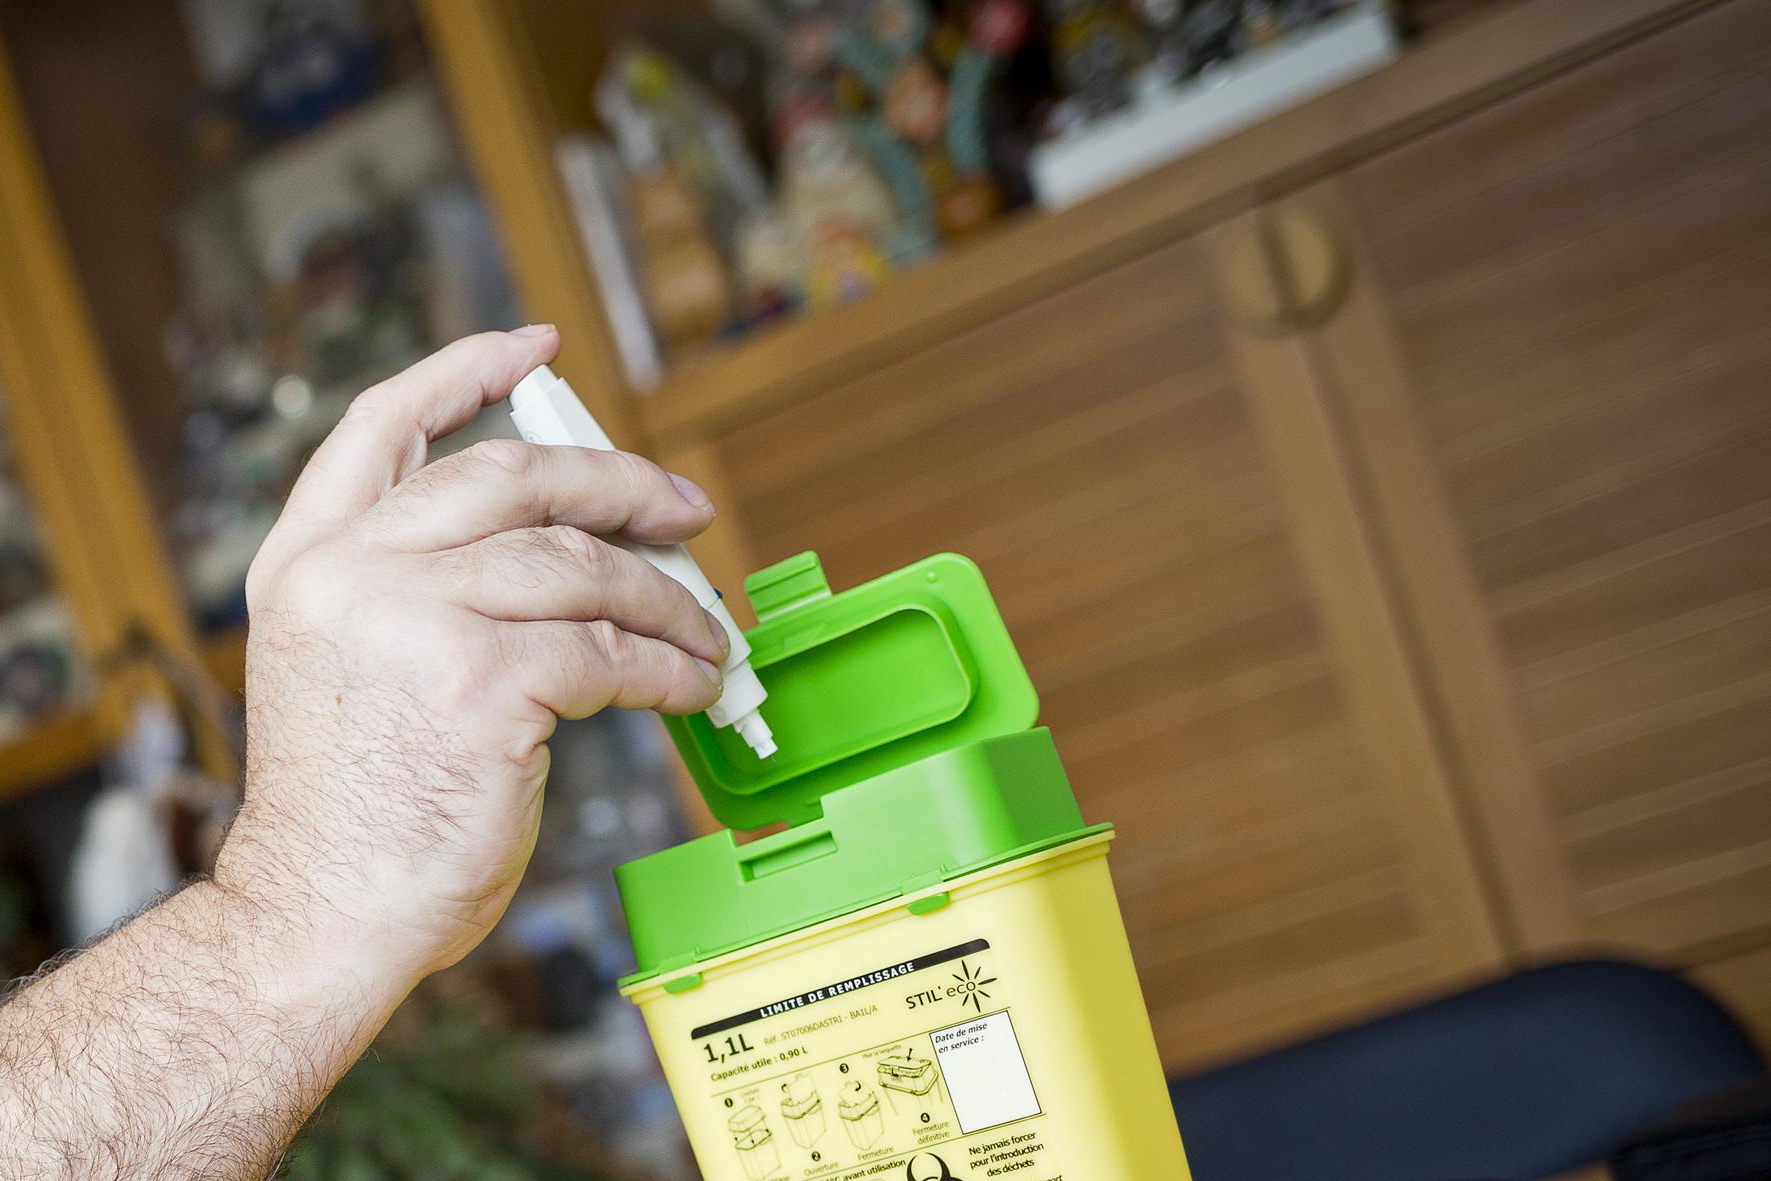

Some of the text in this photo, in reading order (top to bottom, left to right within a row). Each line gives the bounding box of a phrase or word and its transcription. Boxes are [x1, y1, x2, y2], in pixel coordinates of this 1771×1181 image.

[759, 962, 915, 1018] LIMITE DE REMPLISSAGE
[935, 1023, 987, 1044] Date de mise
[703, 1033, 754, 1064] 1,1L
[938, 1046, 948, 1054] en
[950, 1036, 979, 1050] service
[710, 1064, 749, 1081] Capacité
[751, 1058, 771, 1069] utile
[779, 1048, 800, 1061] 0,90
[912, 1121, 949, 1135] Fermeture
[857, 1147, 894, 1161] Fermeture
[968, 1132, 1036, 1155] Ne jamais forcer
[969, 1143, 1044, 1170] pour l'introduction
[843, 1170, 866, 1181] avant
[866, 1159, 906, 1175] utilisation
[986, 1159, 1035, 1177] des déchets
